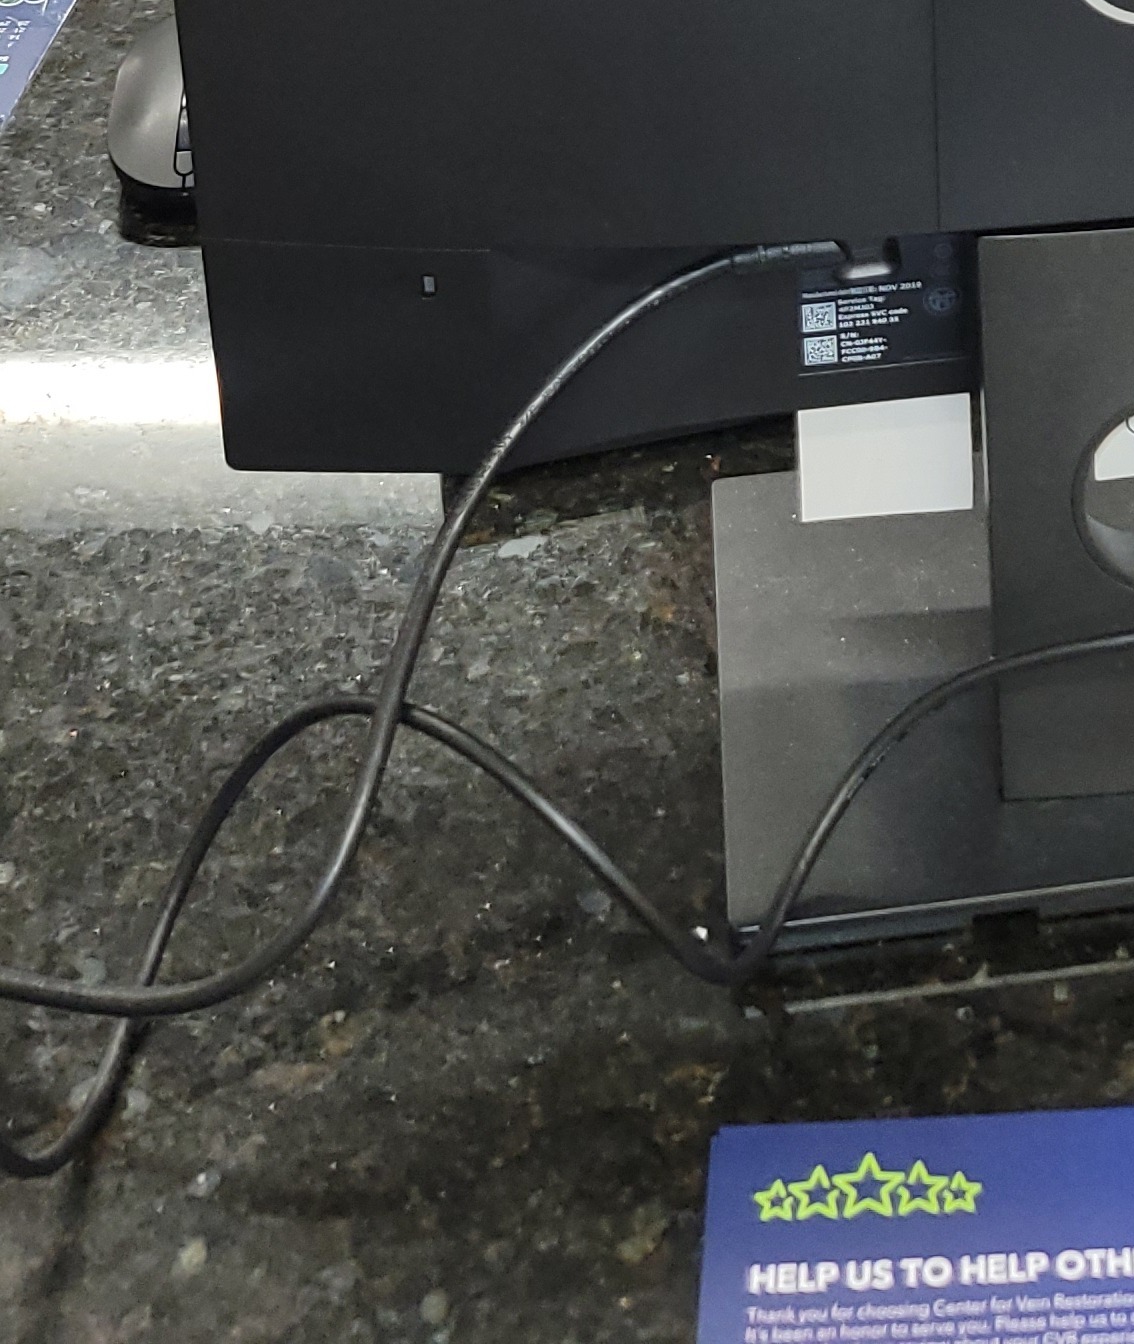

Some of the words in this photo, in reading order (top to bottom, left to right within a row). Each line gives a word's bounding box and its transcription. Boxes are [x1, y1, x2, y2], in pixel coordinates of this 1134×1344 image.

[748, 1262, 840, 1296] HELP
[844, 1259, 895, 1292] US
[900, 1255, 953, 1289] TO
[959, 1250, 1049, 1287] HELP
[746, 1305, 796, 1325] Thank
[799, 1308, 829, 1325] you
[830, 1301, 854, 1321] for
[856, 1302, 931, 1322] choosing
[932, 1298, 987, 1317] Center
[990, 1295, 1013, 1314] for
[1015, 1295, 1051, 1313] Vein
[994, 1315, 1048, 1333] Please
[1049, 1311, 1087, 1331] help
